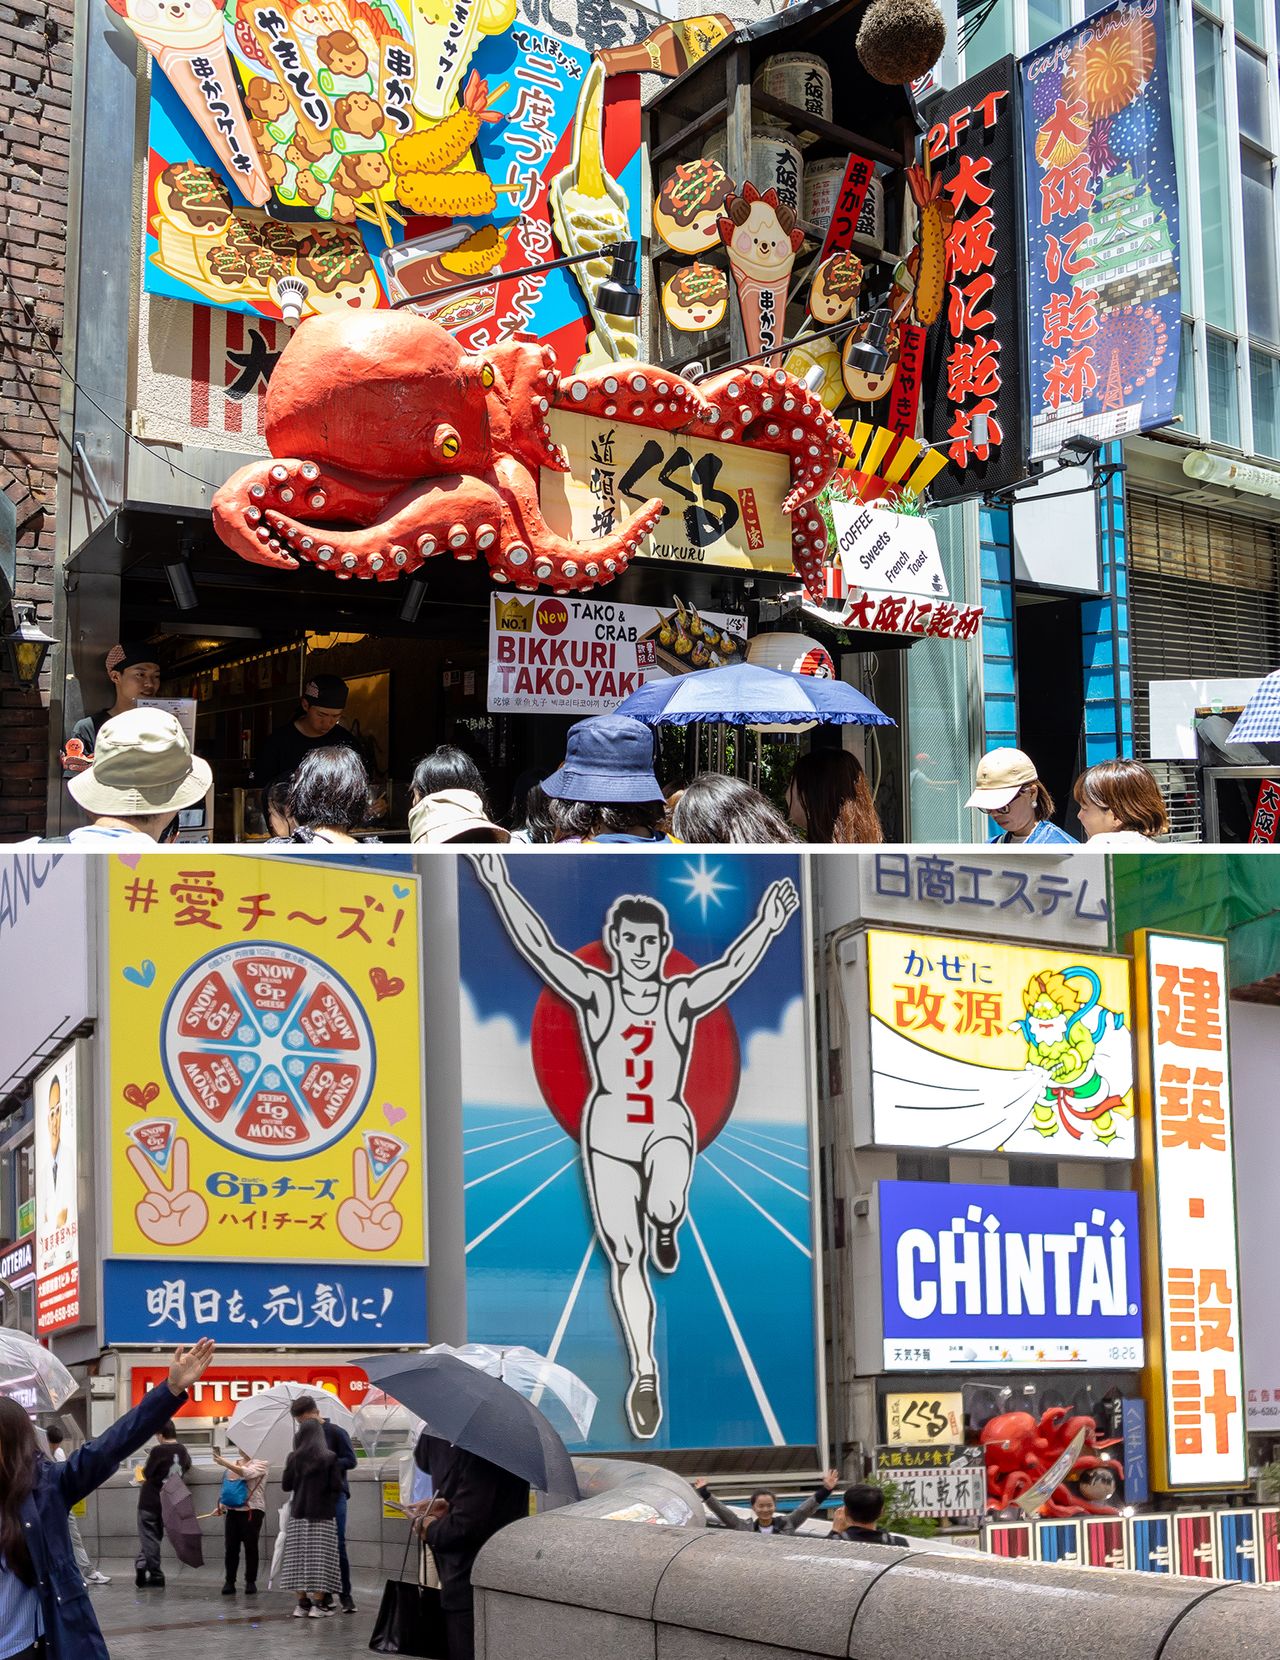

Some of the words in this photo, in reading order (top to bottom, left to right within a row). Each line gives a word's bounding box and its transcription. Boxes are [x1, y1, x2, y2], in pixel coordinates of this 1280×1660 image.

[435, 0, 472, 91] モンサワー
[1027, 43, 1072, 81] Cafe
[1078, 0, 1157, 50] Dining
[257, 9, 328, 130] やきとり
[387, 48, 411, 130] 串かつ
[189, 56, 252, 173] 串かつケーキ
[1038, 98, 1100, 411] 大阪に乾杯
[590, 429, 617, 539] 道頓堀
[617, 439, 740, 549] くくる
[651, 542, 706, 562] KUKURU
[839, 509, 874, 552] COFFEE
[859, 531, 891, 570] Sweets
[884, 550, 910, 584] French
[906, 549, 929, 576] Toast
[501, 618, 528, 631] NO.1
[538, 609, 568, 626] New
[570, 602, 615, 622] TAKO
[618, 611, 626, 623] &
[594, 624, 638, 643] CRAB
[842, 591, 985, 640] 大阪に乾杯
[496, 635, 616, 670] BIKKURI
[875, 854, 1110, 921] 日商エステム
[246, 962, 297, 981] SNOW
[903, 949, 993, 984] かぜに
[185, 979, 218, 1028] SNOW
[321, 994, 356, 1040] SNOW
[893, 983, 1004, 1038] 改源
[183, 1062, 220, 1110] SNOW
[620, 1019, 657, 1125] グリコ
[323, 1073, 355, 1121] SNOW
[247, 1123, 298, 1140] SNOW
[1153, 962, 1237, 1454] 建築・設計
[896, 1210, 1128, 1320] CHINTAI
[901, 1399, 949, 1437] くくる
[1113, 1398, 1122, 1430] 2F
